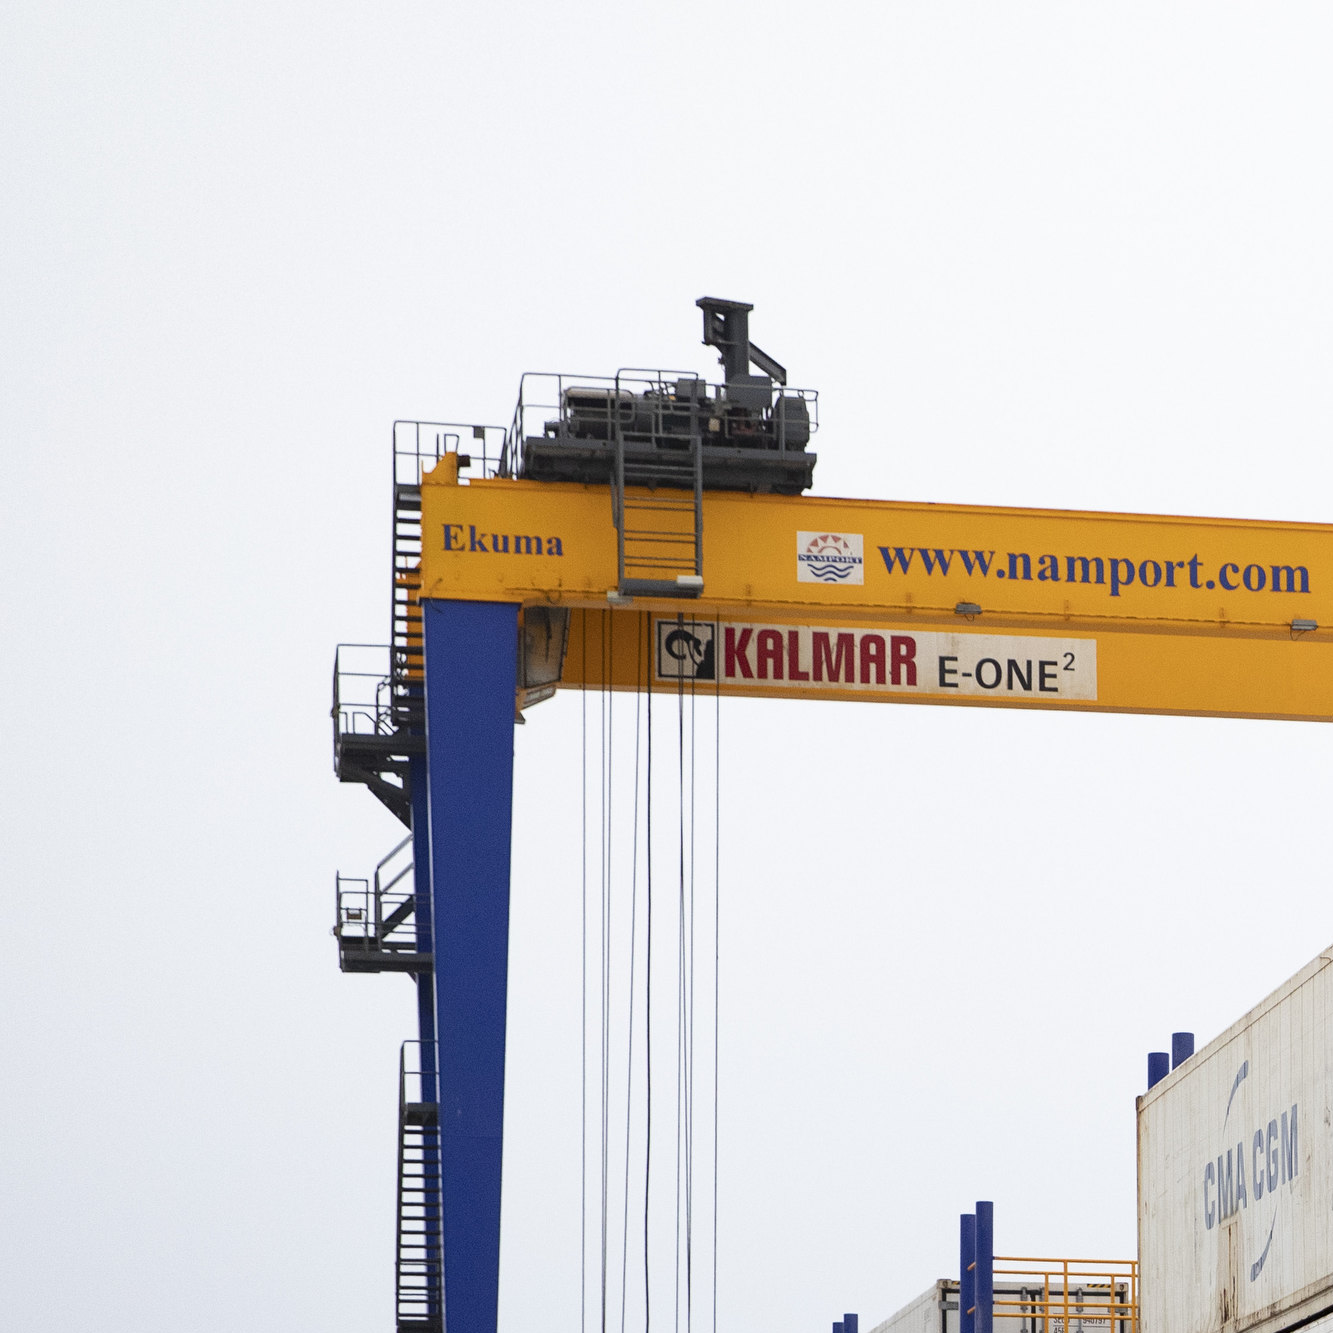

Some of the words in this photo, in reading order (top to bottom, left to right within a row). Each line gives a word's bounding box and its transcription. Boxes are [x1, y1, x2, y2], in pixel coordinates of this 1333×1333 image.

[441, 523, 564, 557] Ekuma
[797, 553, 864, 565] NAMPORT
[877, 545, 1312, 597] www.namport.com
[724, 625, 918, 687] KALMAR
[1202, 1149, 1248, 1231] CMA
[1252, 1102, 1300, 1198] CGM
